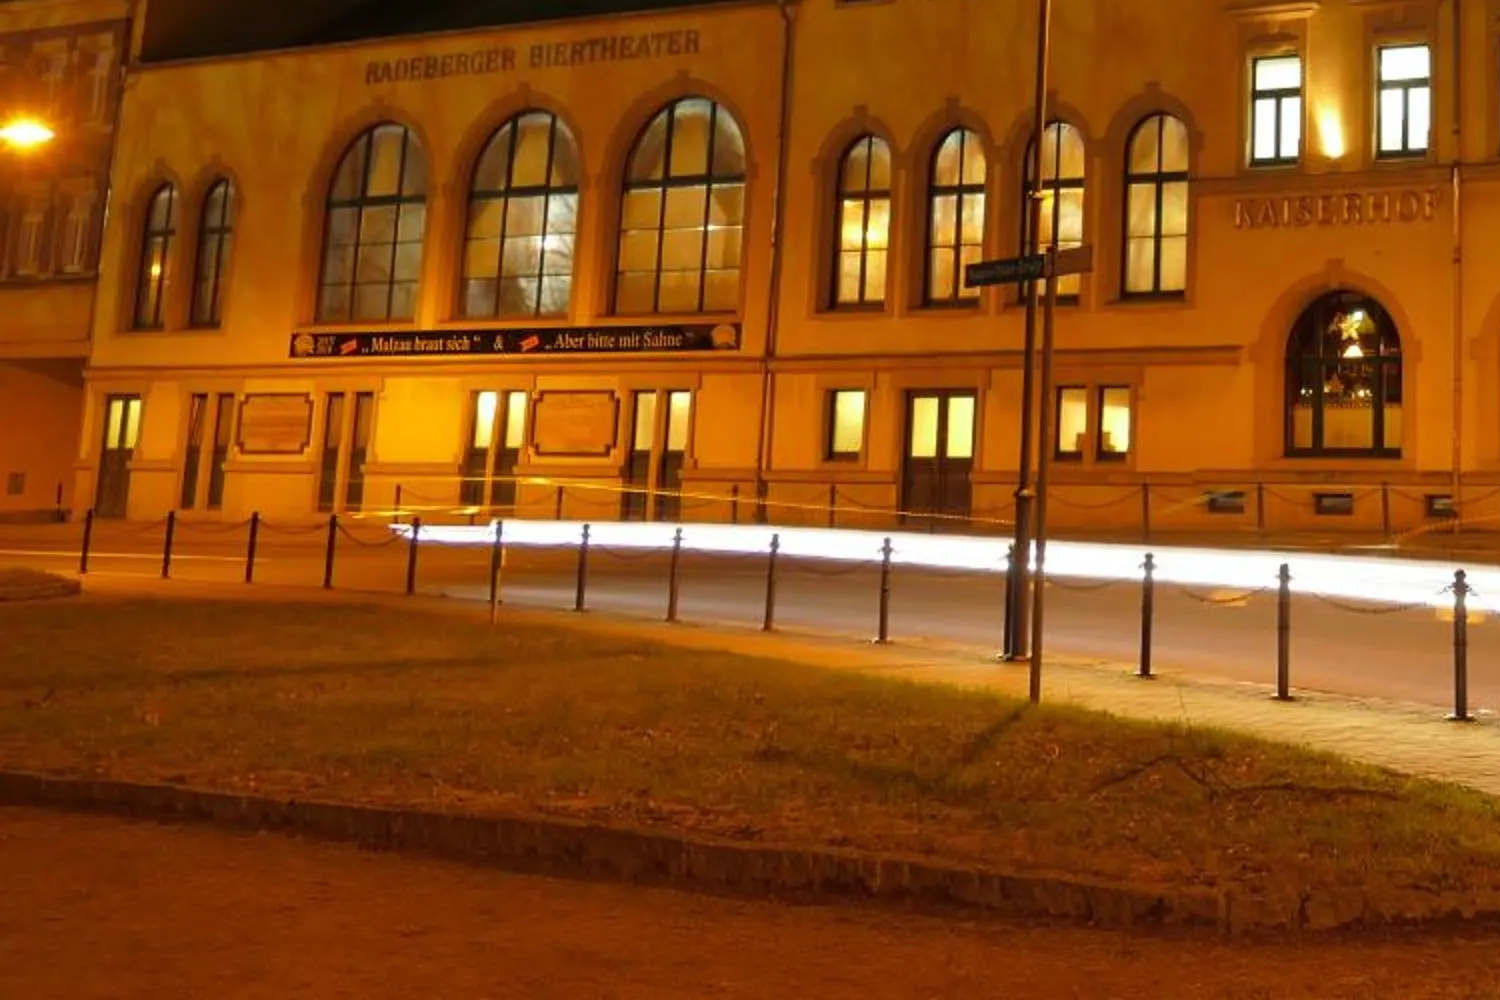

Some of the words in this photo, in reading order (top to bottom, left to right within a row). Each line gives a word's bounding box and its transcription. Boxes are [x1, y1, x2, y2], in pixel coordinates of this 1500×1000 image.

[365, 48, 516, 85] RADEBERGER
[530, 29, 700, 68] BIERTHEATER
[1234, 188, 1442, 229] KAISERHOF
